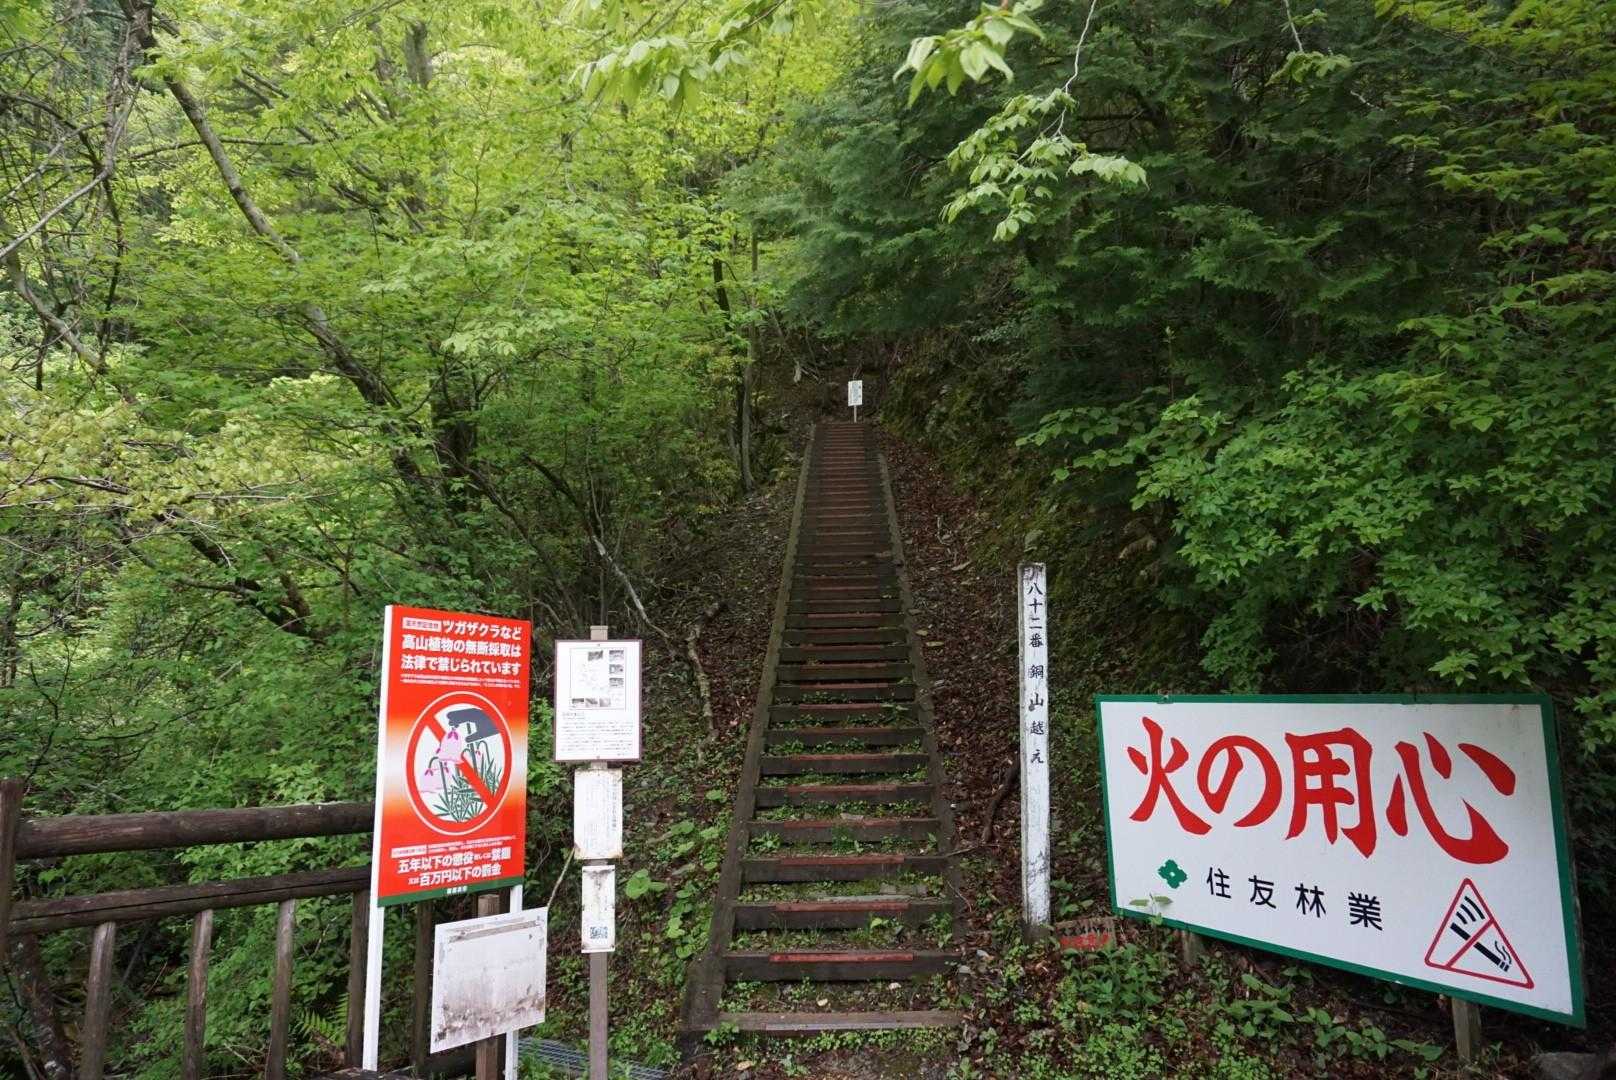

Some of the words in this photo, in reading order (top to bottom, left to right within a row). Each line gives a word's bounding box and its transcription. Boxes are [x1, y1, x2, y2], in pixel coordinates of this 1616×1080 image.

[442, 619, 523, 641] ツガザクラなど
[401, 634, 522, 658] 高山植物の無断採取は
[401, 654, 522, 676] 法律で禁じられています
[1126, 716, 1516, 864] 火の用心
[1206, 867, 1384, 931] 住友林業
